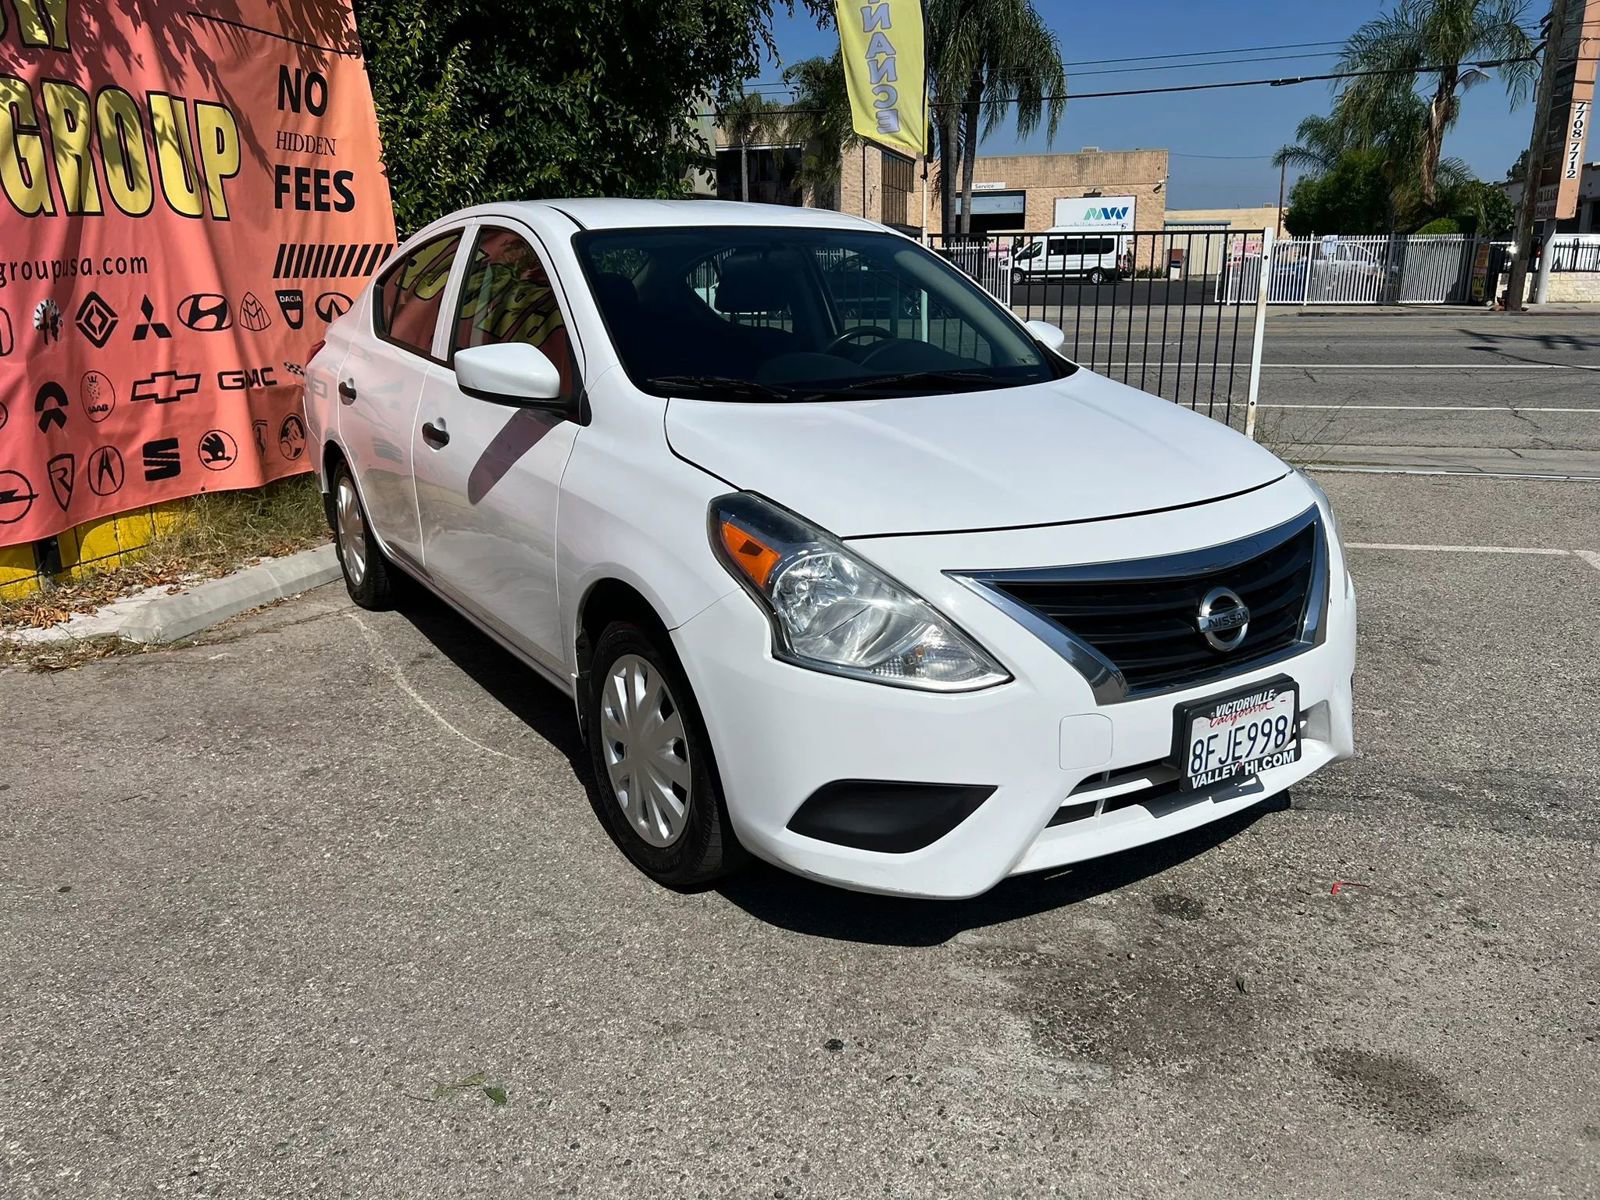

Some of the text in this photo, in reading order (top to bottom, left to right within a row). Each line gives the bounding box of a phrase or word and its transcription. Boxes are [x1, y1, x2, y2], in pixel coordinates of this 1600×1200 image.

[278, 64, 328, 117] NO
[0, 73, 241, 221] GROUP
[276, 130, 337, 156] HIDDEN
[1566, 101, 1587, 179] 7708 7712
[274, 164, 356, 213] FEES
[279, 295, 302, 303] DACIA
[217, 366, 278, 391] GMC
[1208, 610, 1249, 628] NISSAN
[1215, 688, 1275, 718] VICTORVILLE
[1190, 714, 1288, 775] 8FJE998
